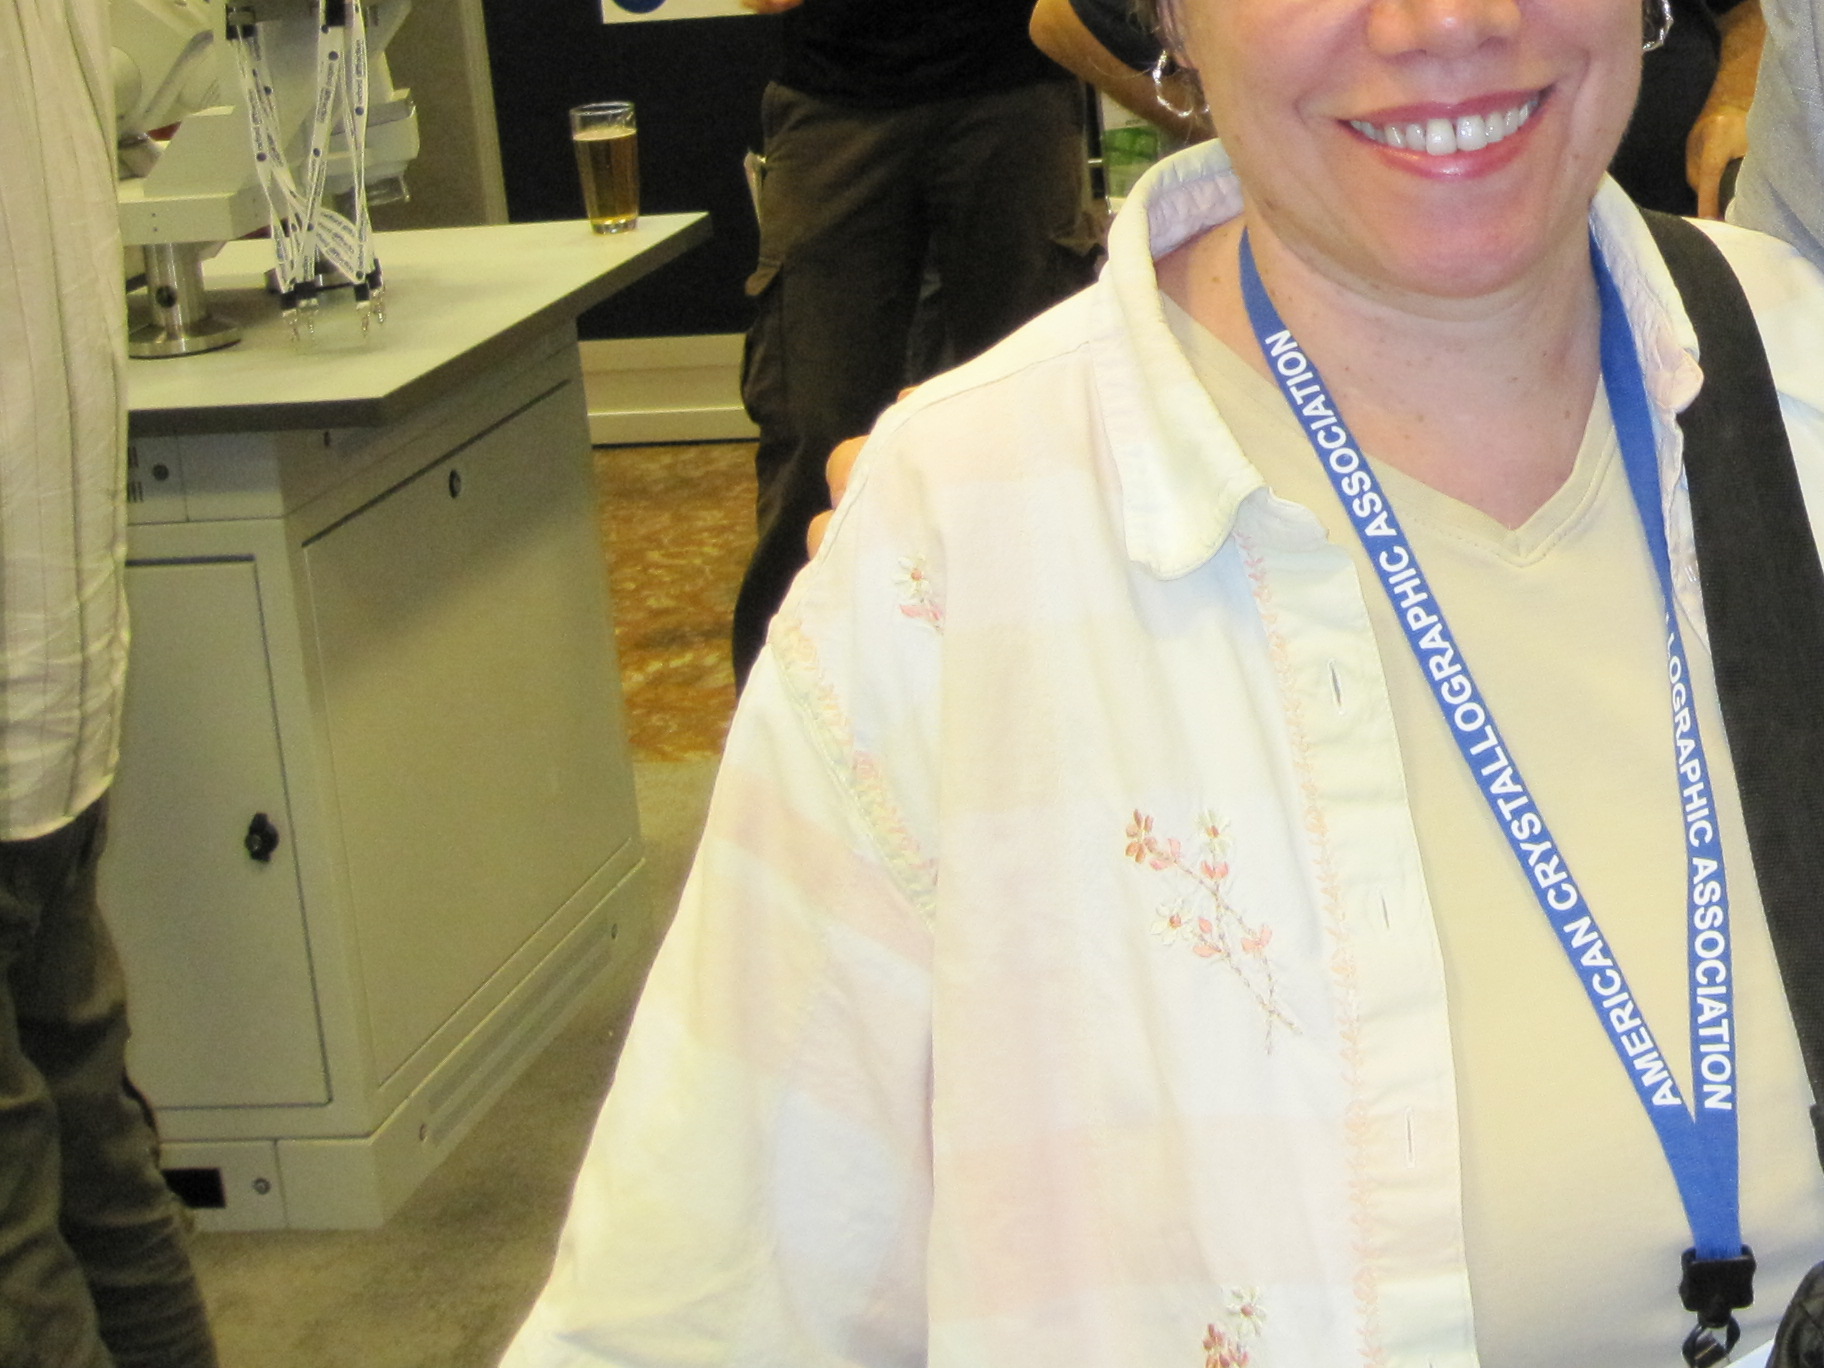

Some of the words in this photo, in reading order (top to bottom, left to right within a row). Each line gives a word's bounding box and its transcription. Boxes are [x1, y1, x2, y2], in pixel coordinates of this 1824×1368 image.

[1265, 329, 1397, 540] ASSOCIATION
[1379, 544, 1578, 913] CRYSTALLOGRAPHIC
[1564, 920, 1682, 1109] AMERICAN
[1692, 856, 1734, 1110] ASSOCIATION
